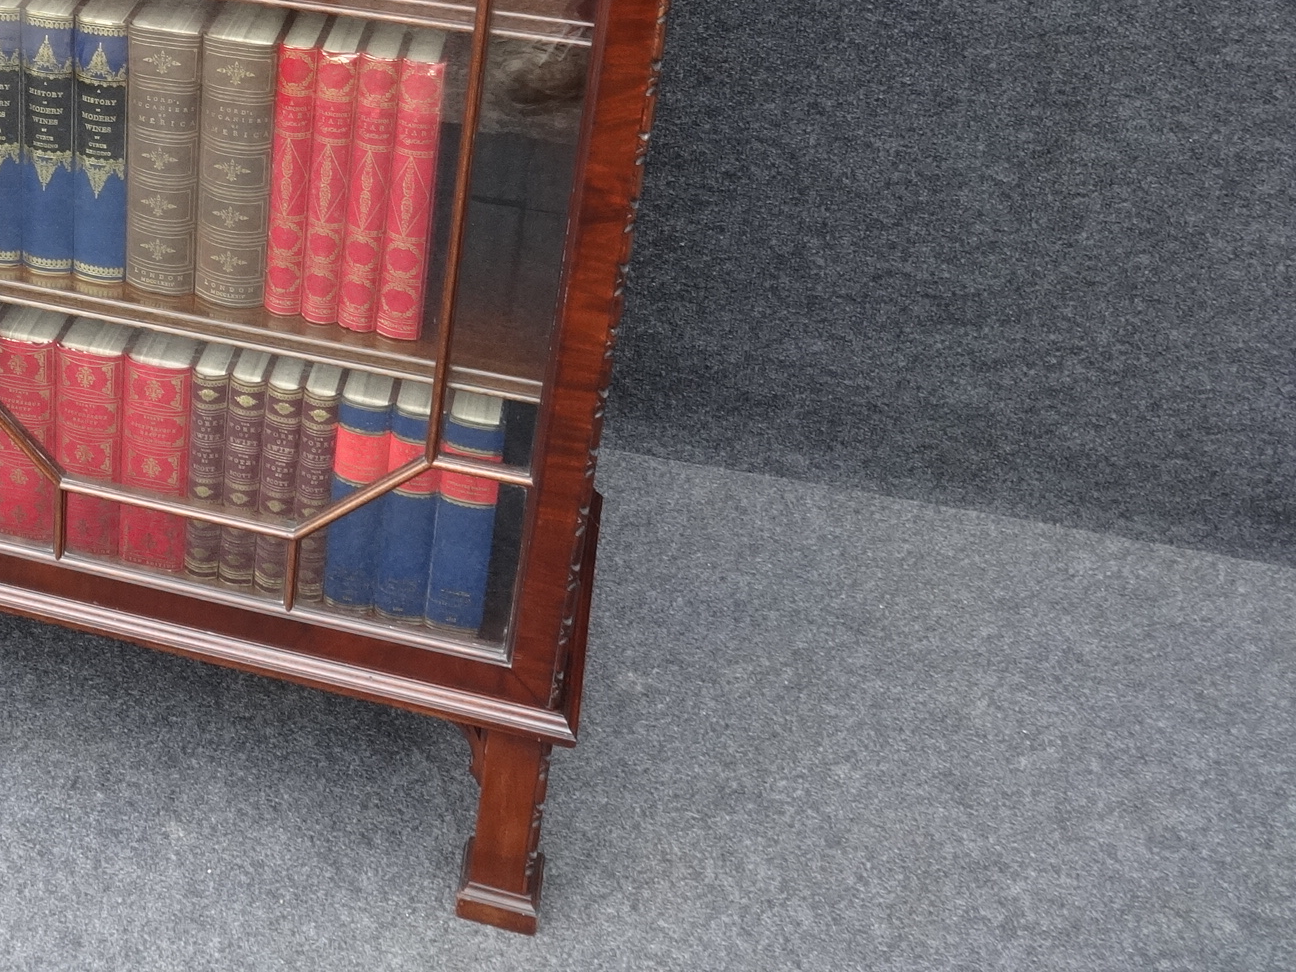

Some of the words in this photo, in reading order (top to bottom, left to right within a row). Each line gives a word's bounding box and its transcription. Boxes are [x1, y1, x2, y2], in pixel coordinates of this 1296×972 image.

[28, 86, 64, 98] HISTORY
[81, 94, 117, 106] HISTORY
[28, 103, 64, 115] MODERN
[31, 115, 59, 126] WINES
[81, 110, 117, 123] MODERN
[138, 114, 196, 128] MERICA
[84, 123, 112, 133] WINES
[134, 266, 184, 282] LONDON
[204, 278, 255, 293] LONDON
[192, 416, 224, 427] ORKS
[193, 432, 221, 441] WIFT
